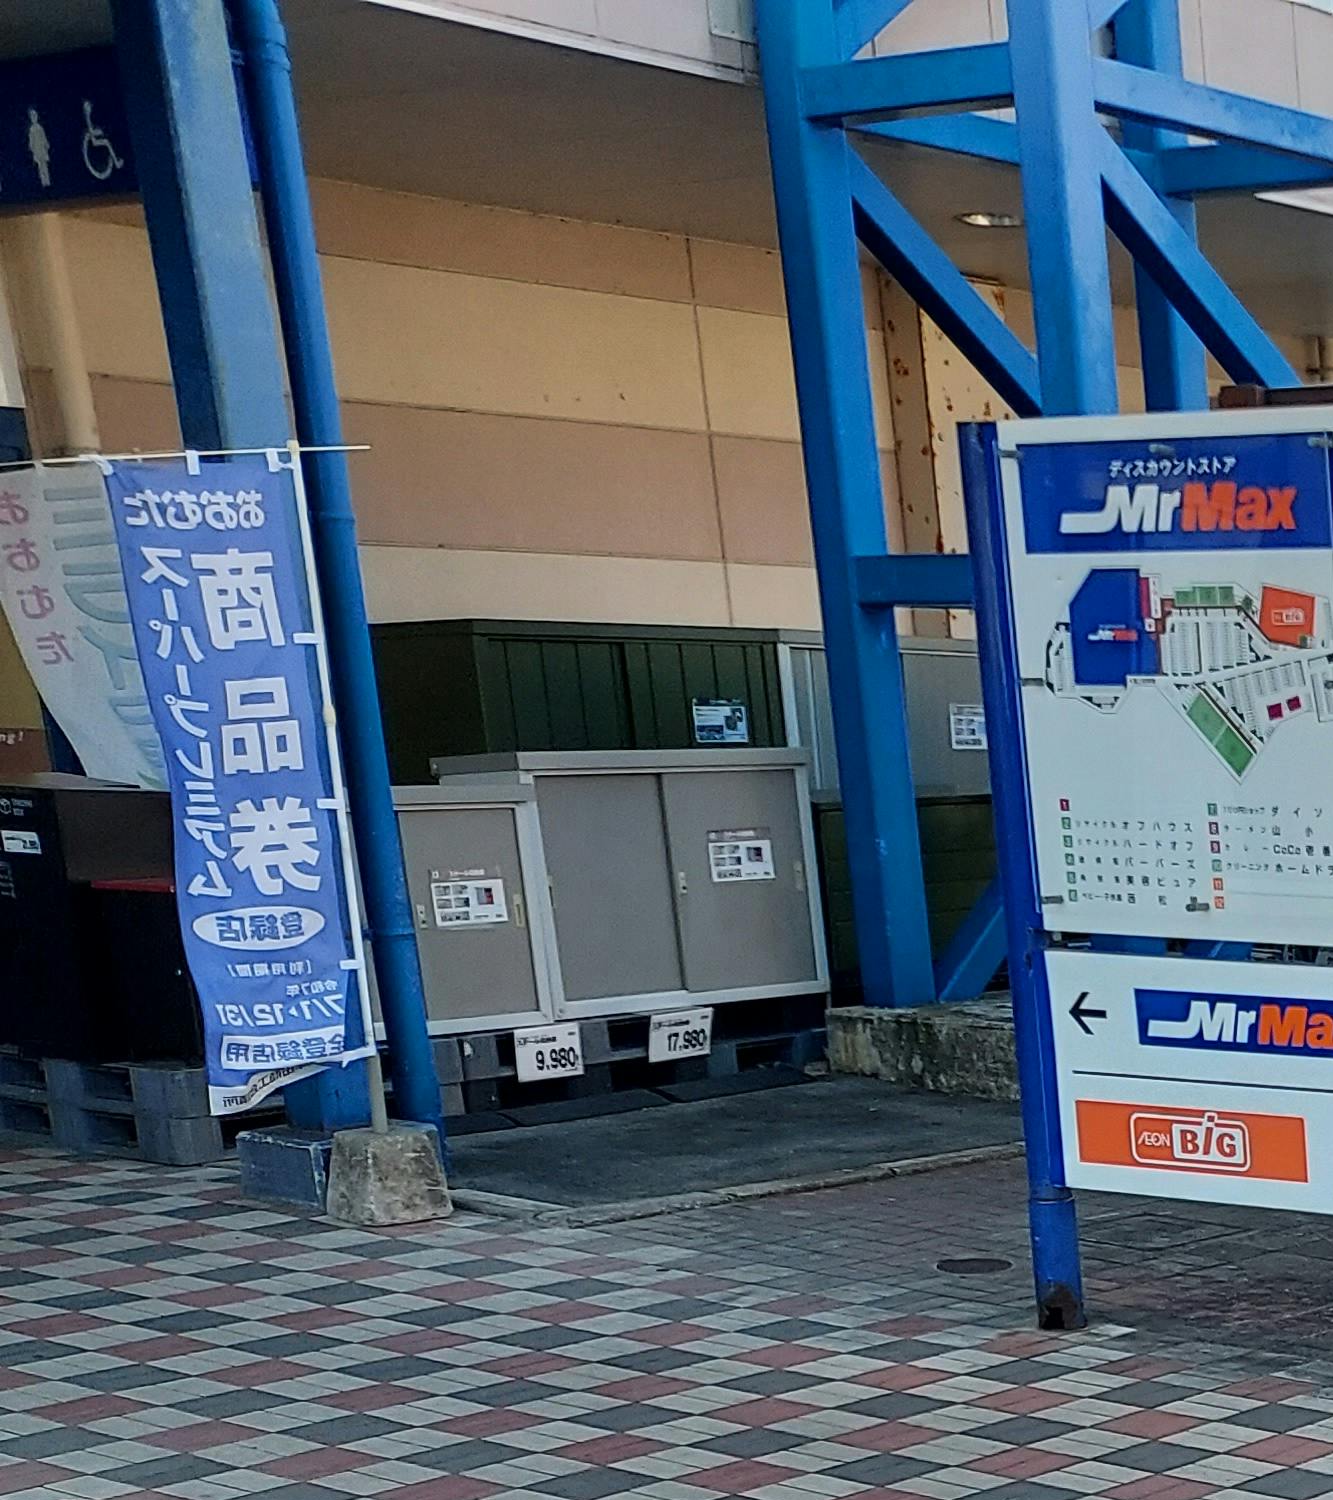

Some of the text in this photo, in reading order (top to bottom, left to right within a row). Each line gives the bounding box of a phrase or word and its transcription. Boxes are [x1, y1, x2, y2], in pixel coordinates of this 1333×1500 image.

[1108, 456, 1237, 479] ディスカウントストア
[1059, 480, 1298, 534] MrMax
